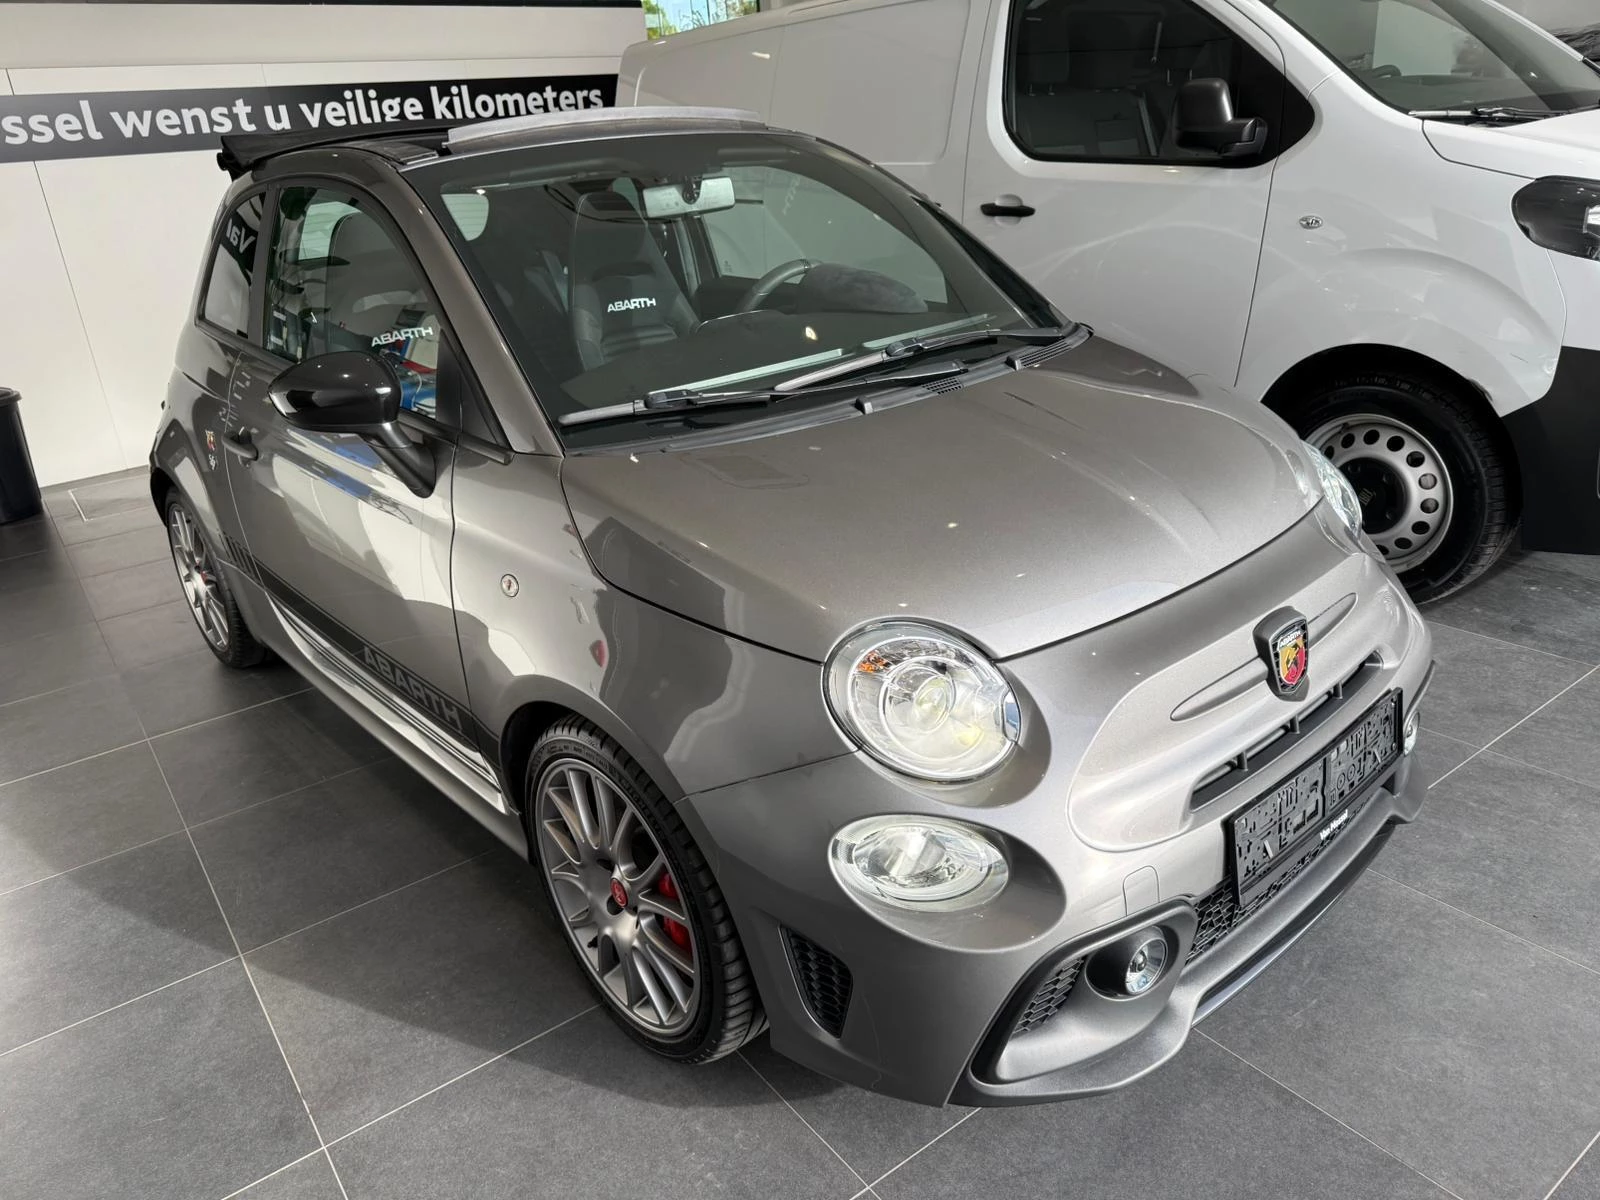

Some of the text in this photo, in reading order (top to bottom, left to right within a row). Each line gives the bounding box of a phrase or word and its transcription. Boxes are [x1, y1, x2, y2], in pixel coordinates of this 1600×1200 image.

[1, 85, 602, 145] ssel wenst u veilige kilometers
[606, 297, 657, 313] ABARTH
[371, 327, 434, 348] ABARTH
[364, 646, 463, 731] ABARTH
